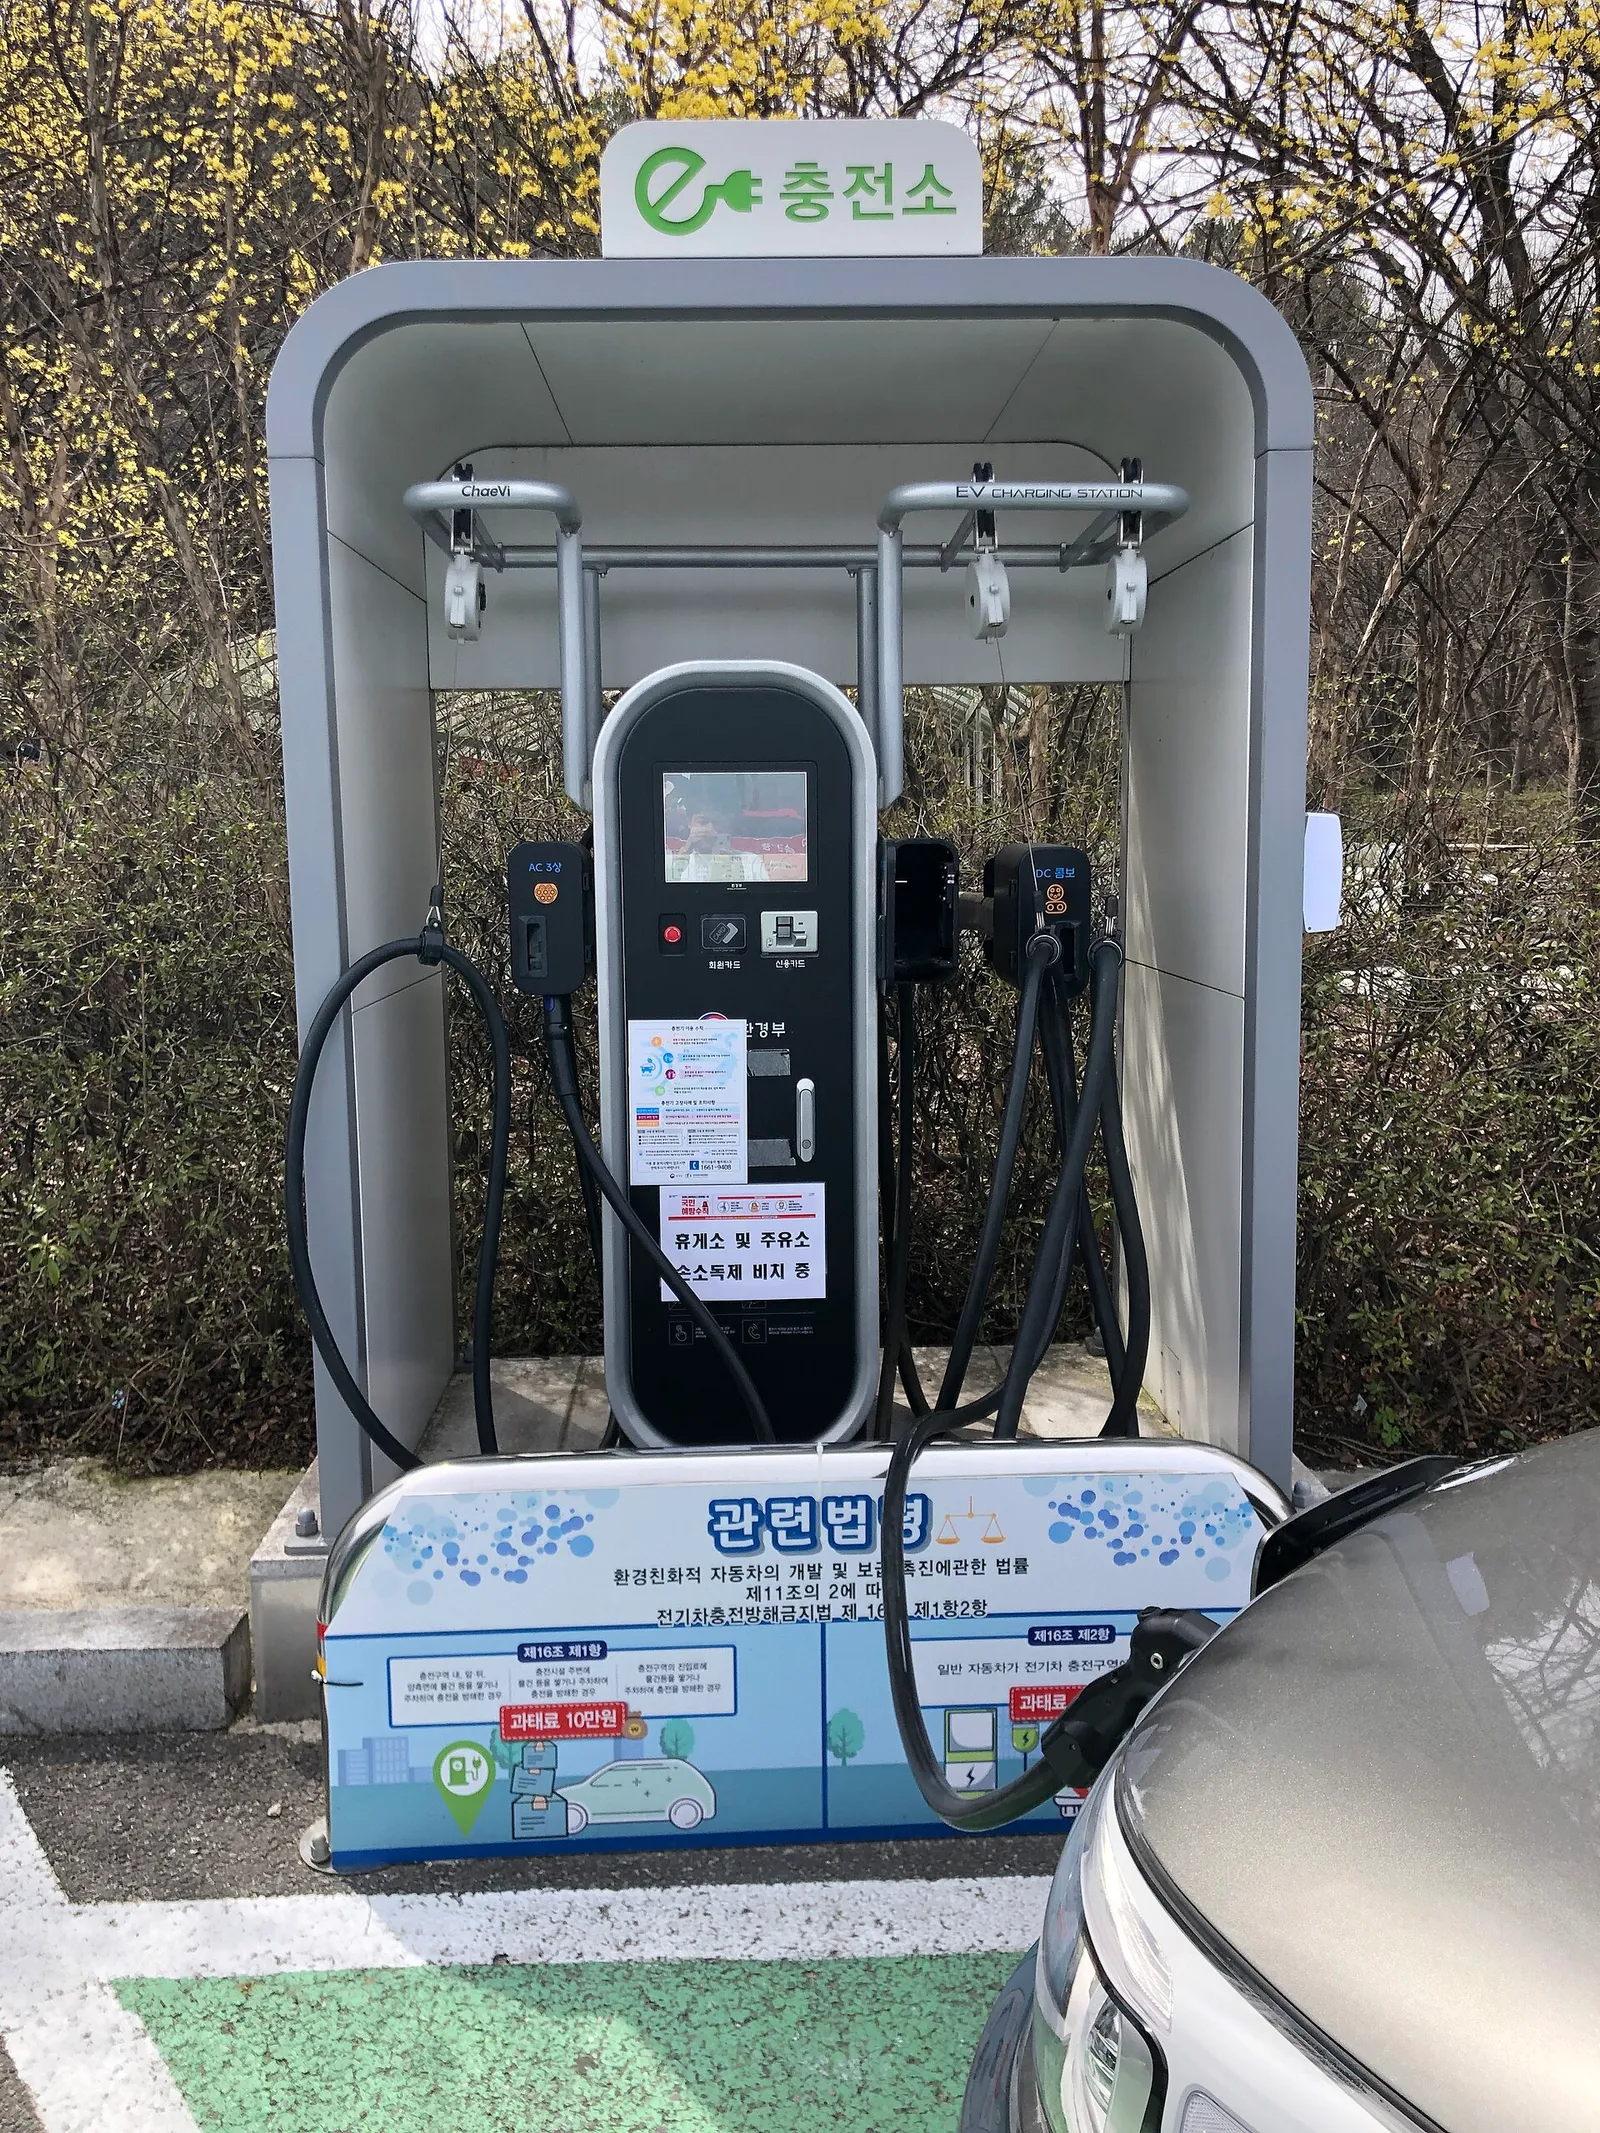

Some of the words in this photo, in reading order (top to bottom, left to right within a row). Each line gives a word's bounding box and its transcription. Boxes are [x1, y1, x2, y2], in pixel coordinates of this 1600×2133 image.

[779, 162, 957, 223] 충전소
[461, 484, 511, 497] ChaeVi
[956, 486, 985, 498] EV
[992, 488, 1072, 498] CHARGING
[1077, 488, 1143, 498] STATION
[528, 863, 543, 872] AC
[546, 862, 562, 873] 3상
[1036, 869, 1051, 878] DC
[1055, 867, 1075, 879] 콤보
[708, 960, 741, 970] 회원카드
[775, 959, 806, 969] 신용카드
[675, 1233, 725, 1250] 휴게소
[736, 1232, 750, 1249] 및
[760, 1231, 810, 1248] 주유소
[677, 1264, 742, 1281] 손소독제
[753, 1263, 784, 1280] 비치
[795, 1262, 810, 1279] 중
[613, 1566, 701, 1586] 환경친화적
[710, 1564, 779, 1583] 자동차의
[790, 1562, 823, 1580] 개발
[832, 1562, 848, 1579] 및
[996, 1557, 1029, 1576] 법률
[746, 1584, 819, 1602] 제11조의
[829, 1583, 856, 1600] 2에
[657, 1604, 831, 1626] 전기차충전방해금지법
[842, 1604, 857, 1621] 제
[914, 1599, 988, 1619] 제1항2항
[1034, 1629, 1074, 1643] 제16조
[1077, 1628, 1110, 1642] 제2항
[524, 1645, 564, 1659] 제16조
[568, 1644, 602, 1658] 제1항
[938, 1663, 962, 1676] 일반
[968, 1662, 1019, 1674] 자동차가
[1025, 1661, 1062, 1673] 전기차
[1067, 1659, 1125, 1672] 충전구역
[1019, 1694, 1067, 1712] 과태료
[510, 1712, 560, 1731] 과태료
[566, 1709, 617, 1729] 10만원
